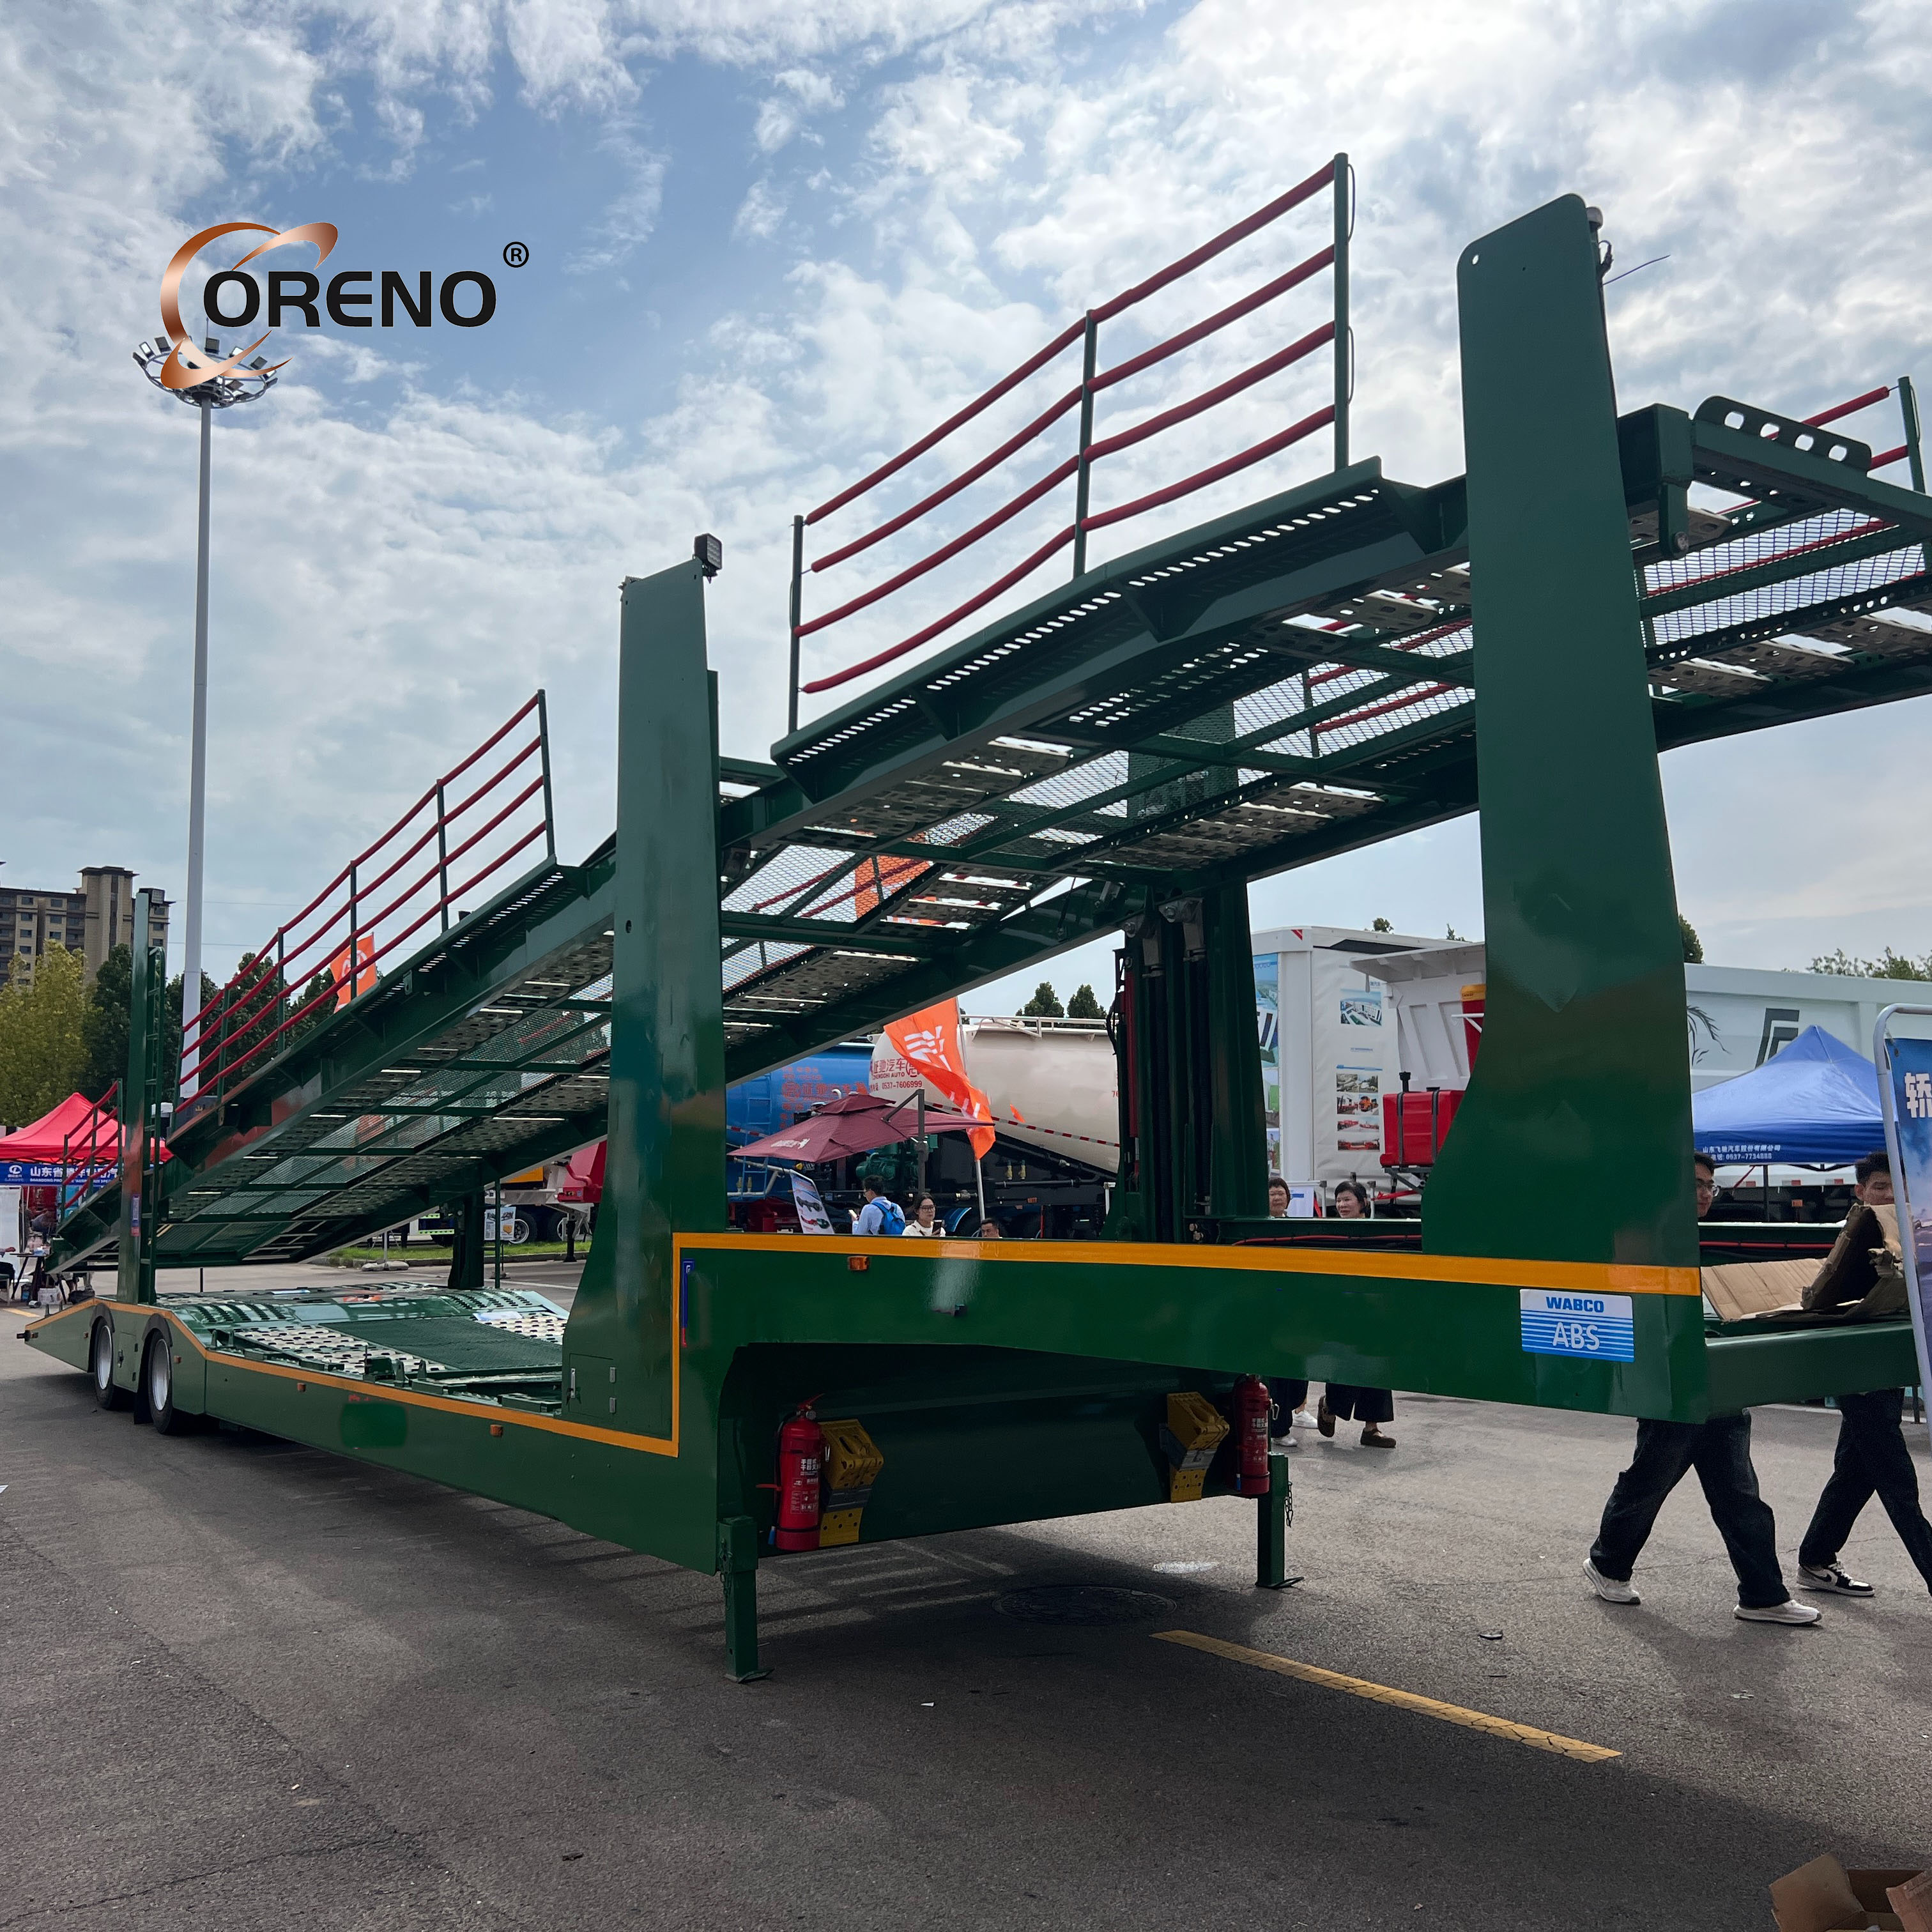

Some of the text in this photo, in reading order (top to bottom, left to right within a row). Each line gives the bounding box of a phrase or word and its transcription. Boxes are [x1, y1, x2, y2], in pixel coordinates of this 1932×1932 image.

[882, 1080, 923, 1089] 0537-7606999
[1546, 1296, 1604, 1313] WABCO
[1552, 1322, 1600, 1351] ABS
